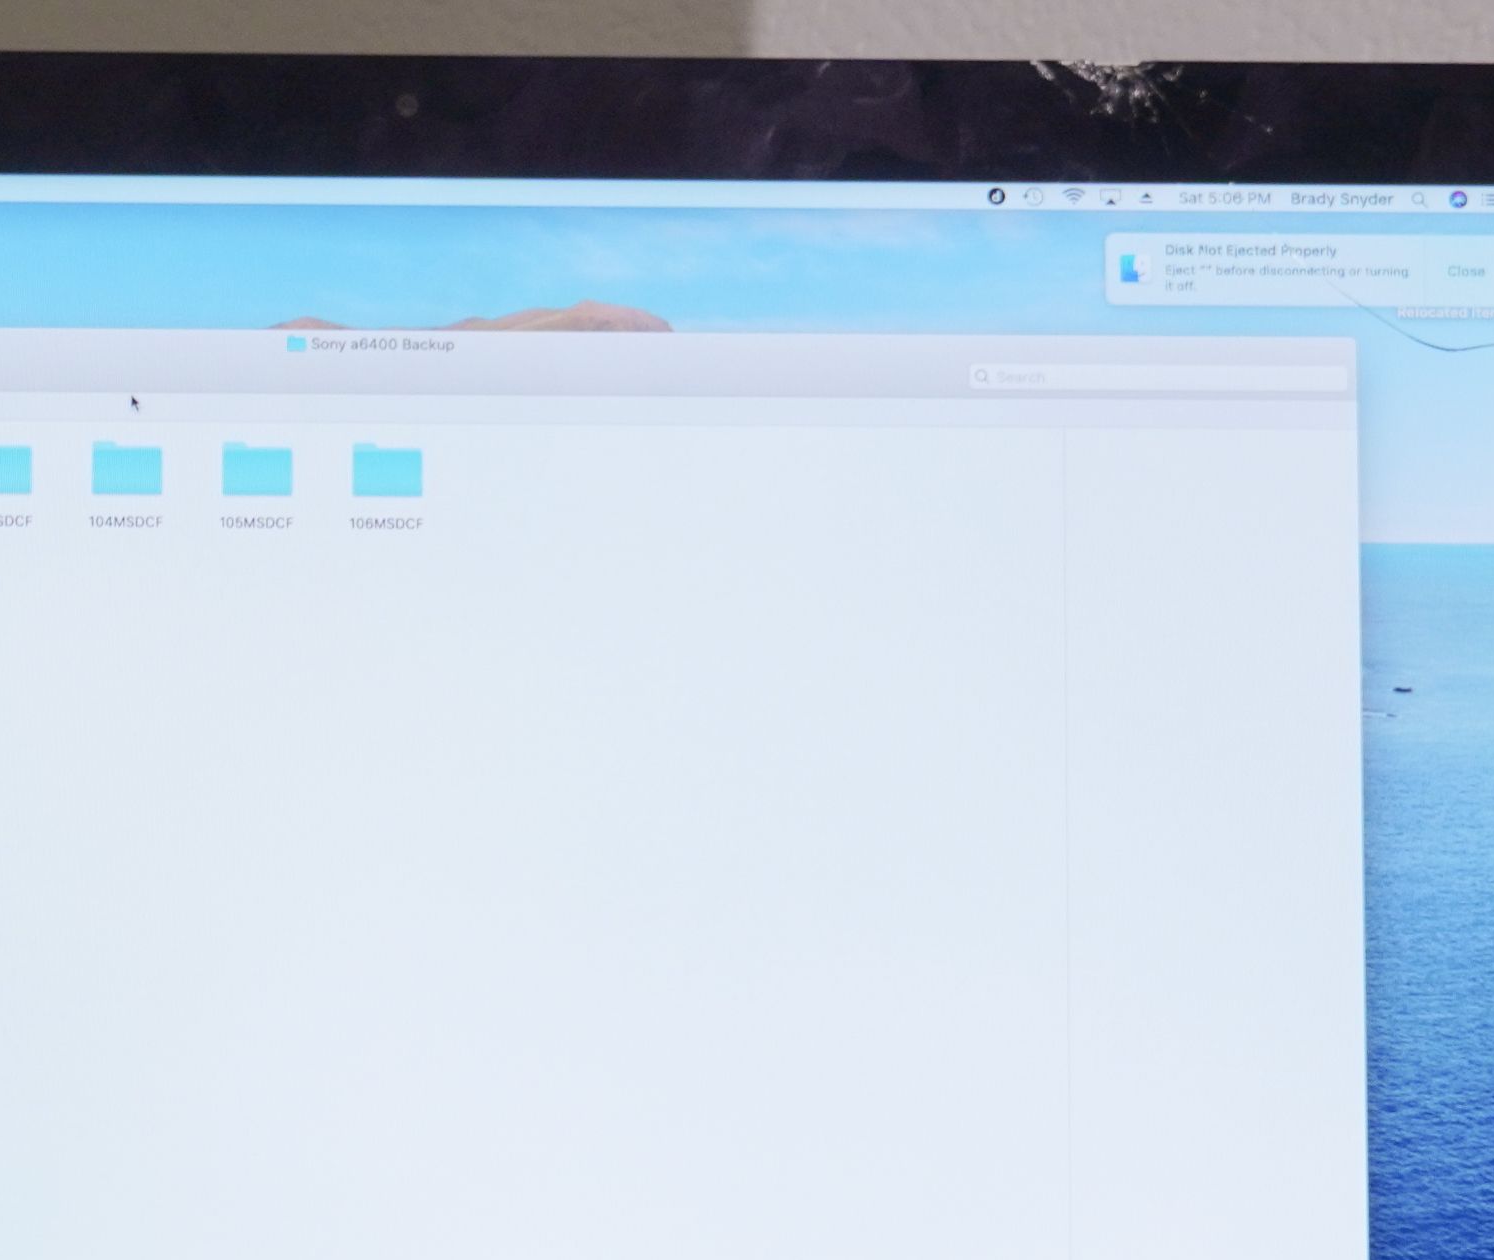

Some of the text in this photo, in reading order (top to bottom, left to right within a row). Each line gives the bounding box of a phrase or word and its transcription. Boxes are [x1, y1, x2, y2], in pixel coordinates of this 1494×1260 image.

[1179, 191, 1203, 205] Sat
[1247, 192, 1272, 206] PM
[1290, 192, 1394, 209] Brady Snyder
[1165, 244, 1337, 259] Disk Not Ejected Properly
[1165, 264, 1196, 278] Eject
[1215, 264, 1255, 277] before
[1259, 265, 1345, 279] disconnecting
[1349, 267, 1360, 278] or
[1365, 265, 1410, 280] turning
[1447, 265, 1486, 278] Close
[311, 337, 455, 355] Sony a6400 Backup
[89, 515, 163, 529] 104MSDCF
[220, 516, 294, 530] 105MSDCF
[349, 516, 424, 531] 106MSDCF
